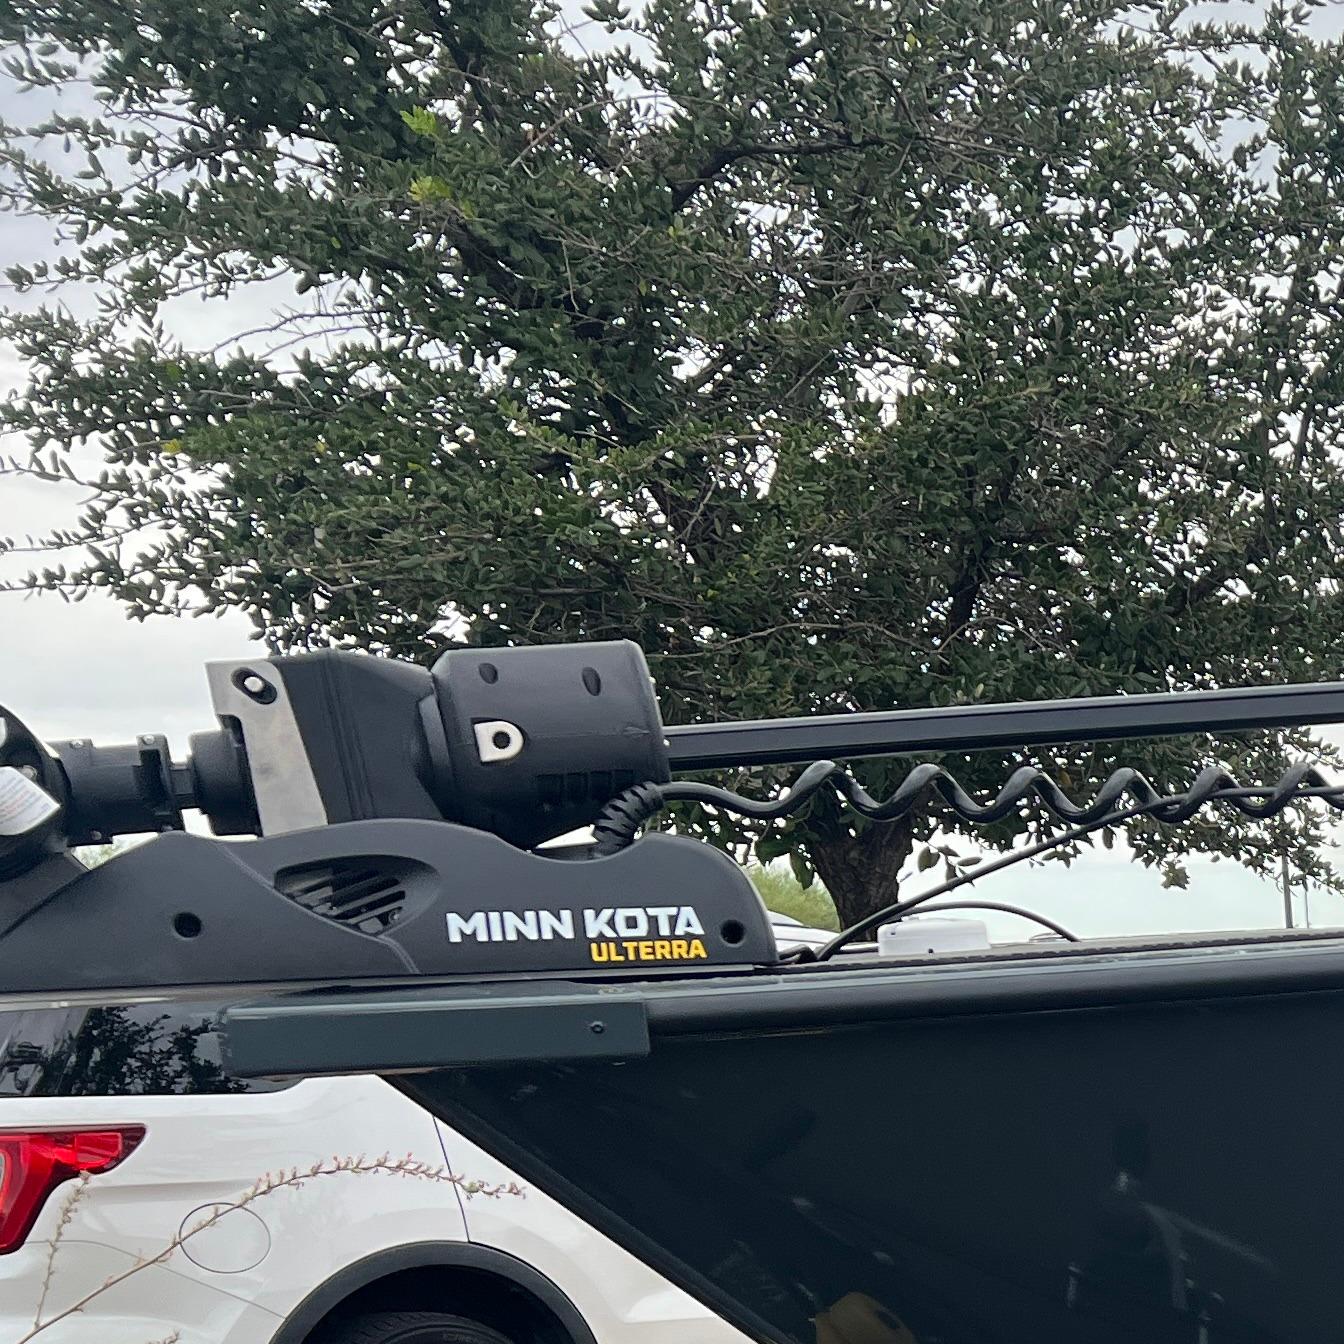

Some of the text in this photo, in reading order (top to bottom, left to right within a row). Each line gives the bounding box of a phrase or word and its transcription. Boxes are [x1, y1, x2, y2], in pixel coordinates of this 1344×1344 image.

[446, 906, 705, 942] MINN KOTA
[591, 939, 708, 962] ULTERRA
